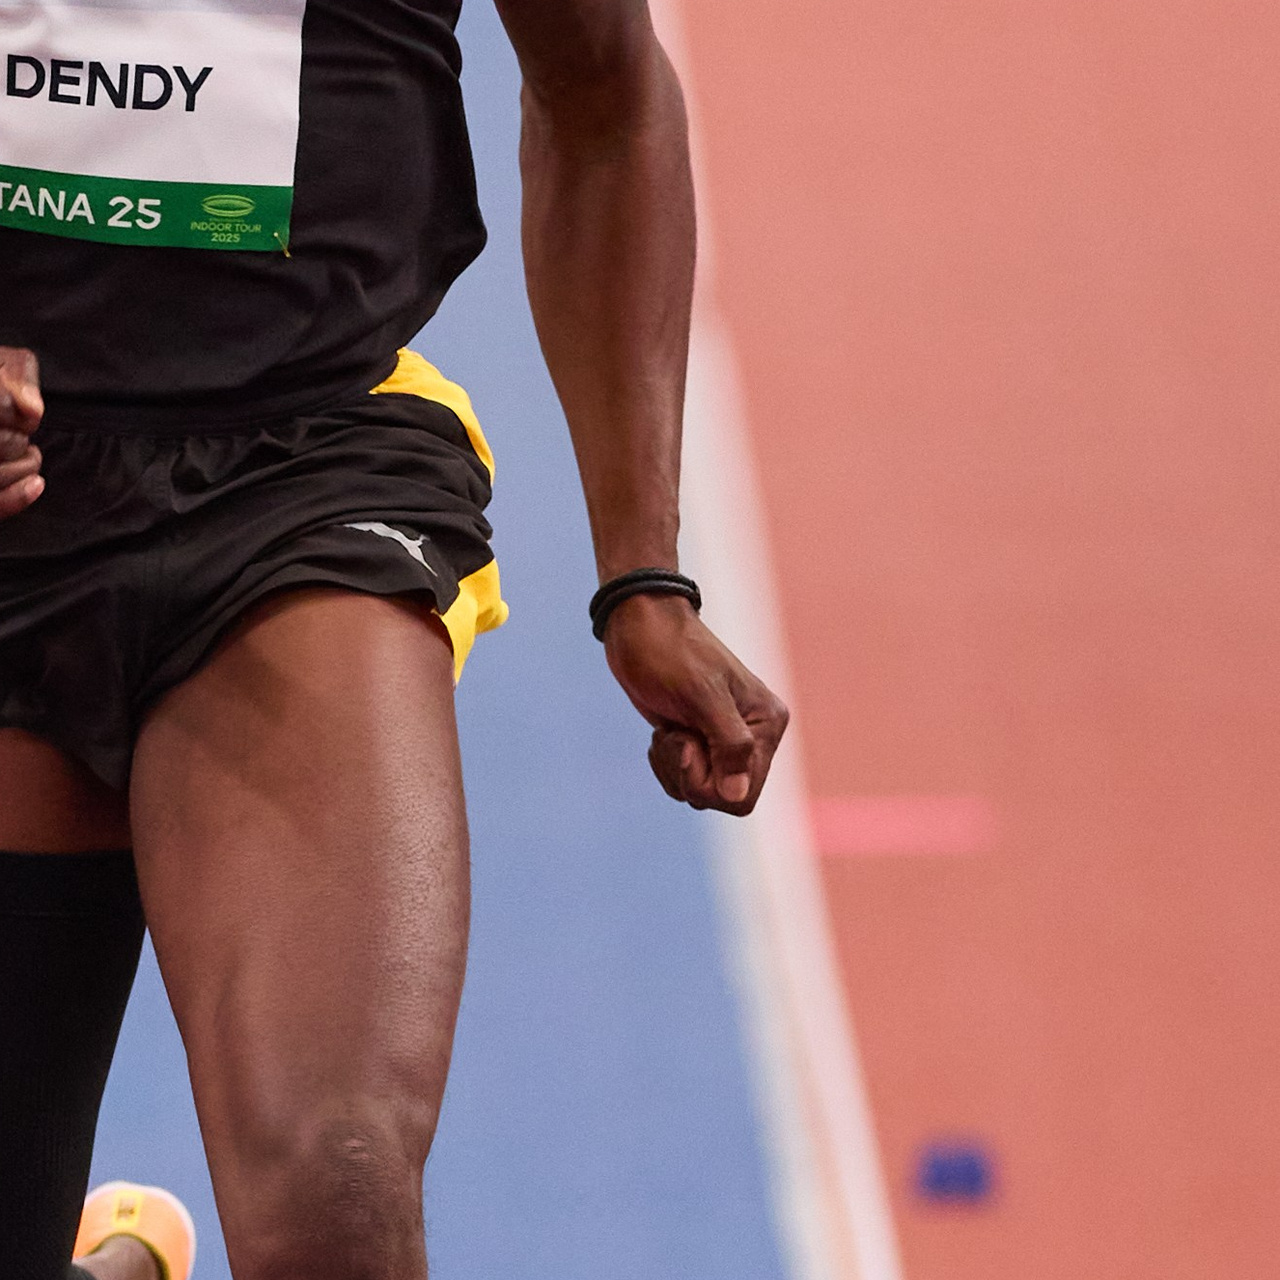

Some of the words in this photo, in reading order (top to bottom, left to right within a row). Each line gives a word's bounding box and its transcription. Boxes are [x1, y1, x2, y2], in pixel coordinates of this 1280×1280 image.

[6, 54, 213, 112] DENDY
[107, 196, 161, 230] 25
[190, 221, 232, 232] INDOOR
[235, 223, 262, 233] TOUR
[211, 232, 241, 243] 2025
